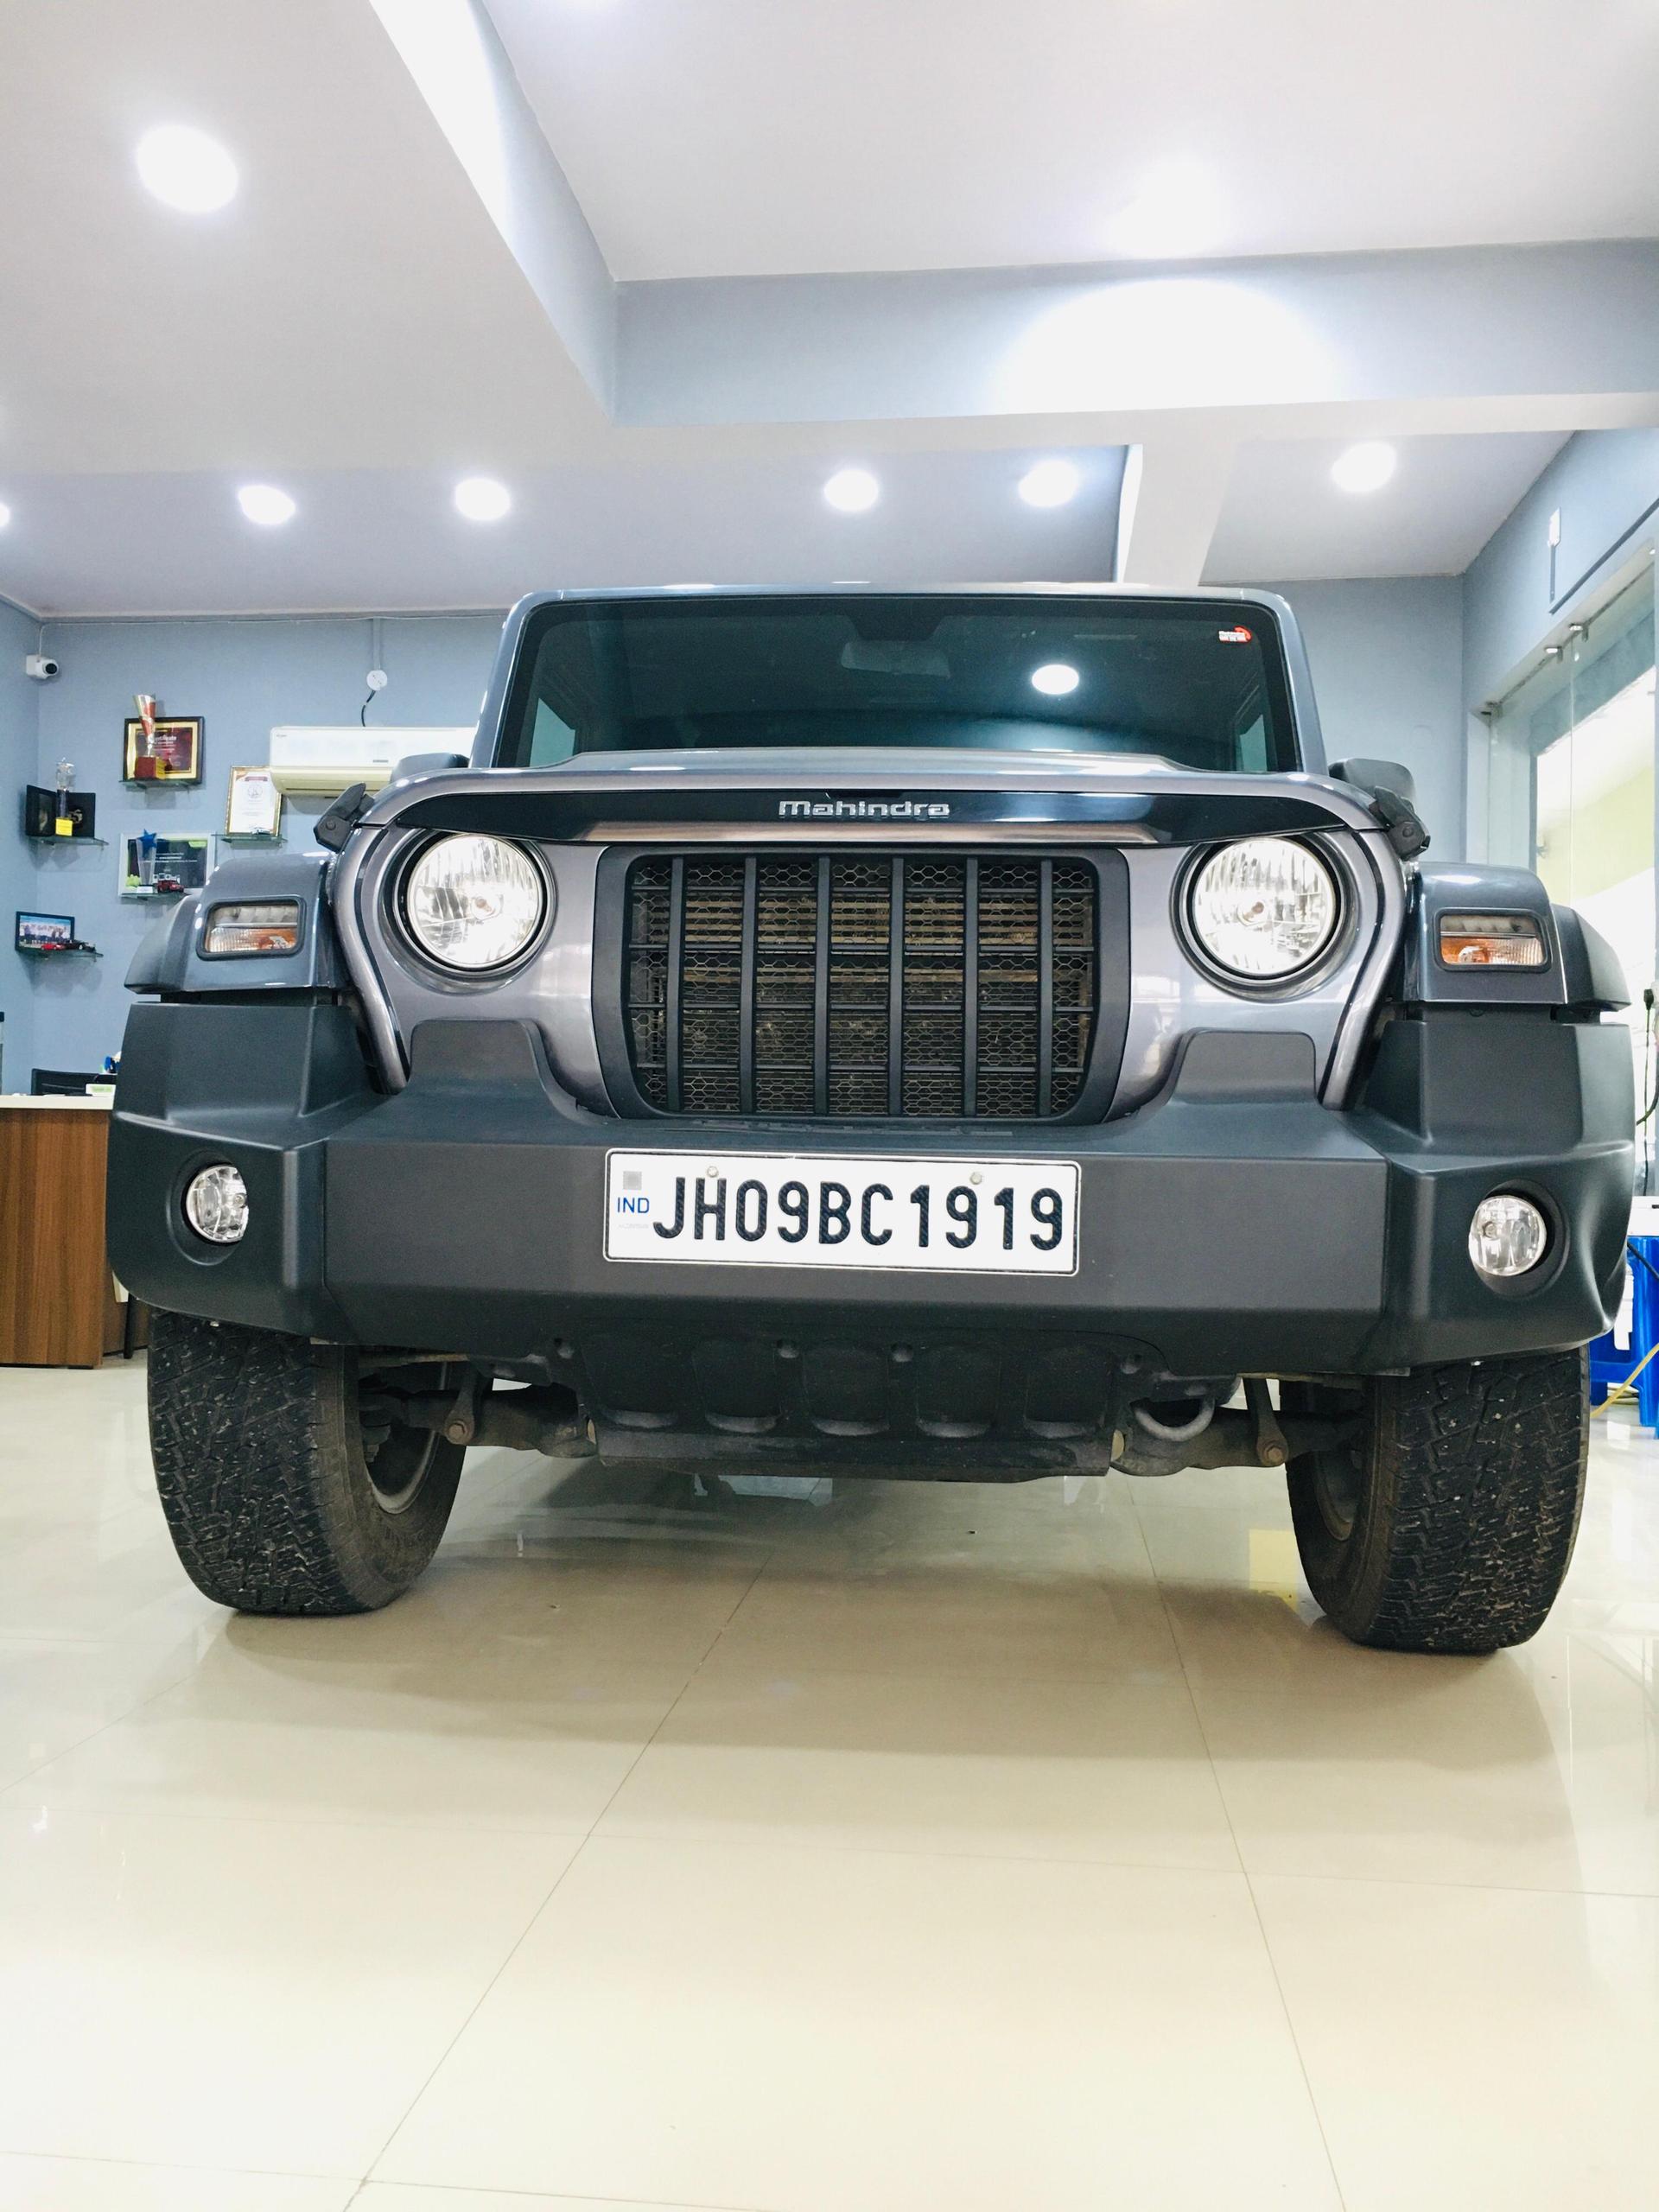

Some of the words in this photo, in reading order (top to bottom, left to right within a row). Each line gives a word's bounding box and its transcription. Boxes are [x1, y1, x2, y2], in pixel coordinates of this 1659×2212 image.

[779, 800, 950, 817] Mahindra
[617, 1197, 651, 1215] IND
[653, 1177, 1063, 1251] JH09BC1919
